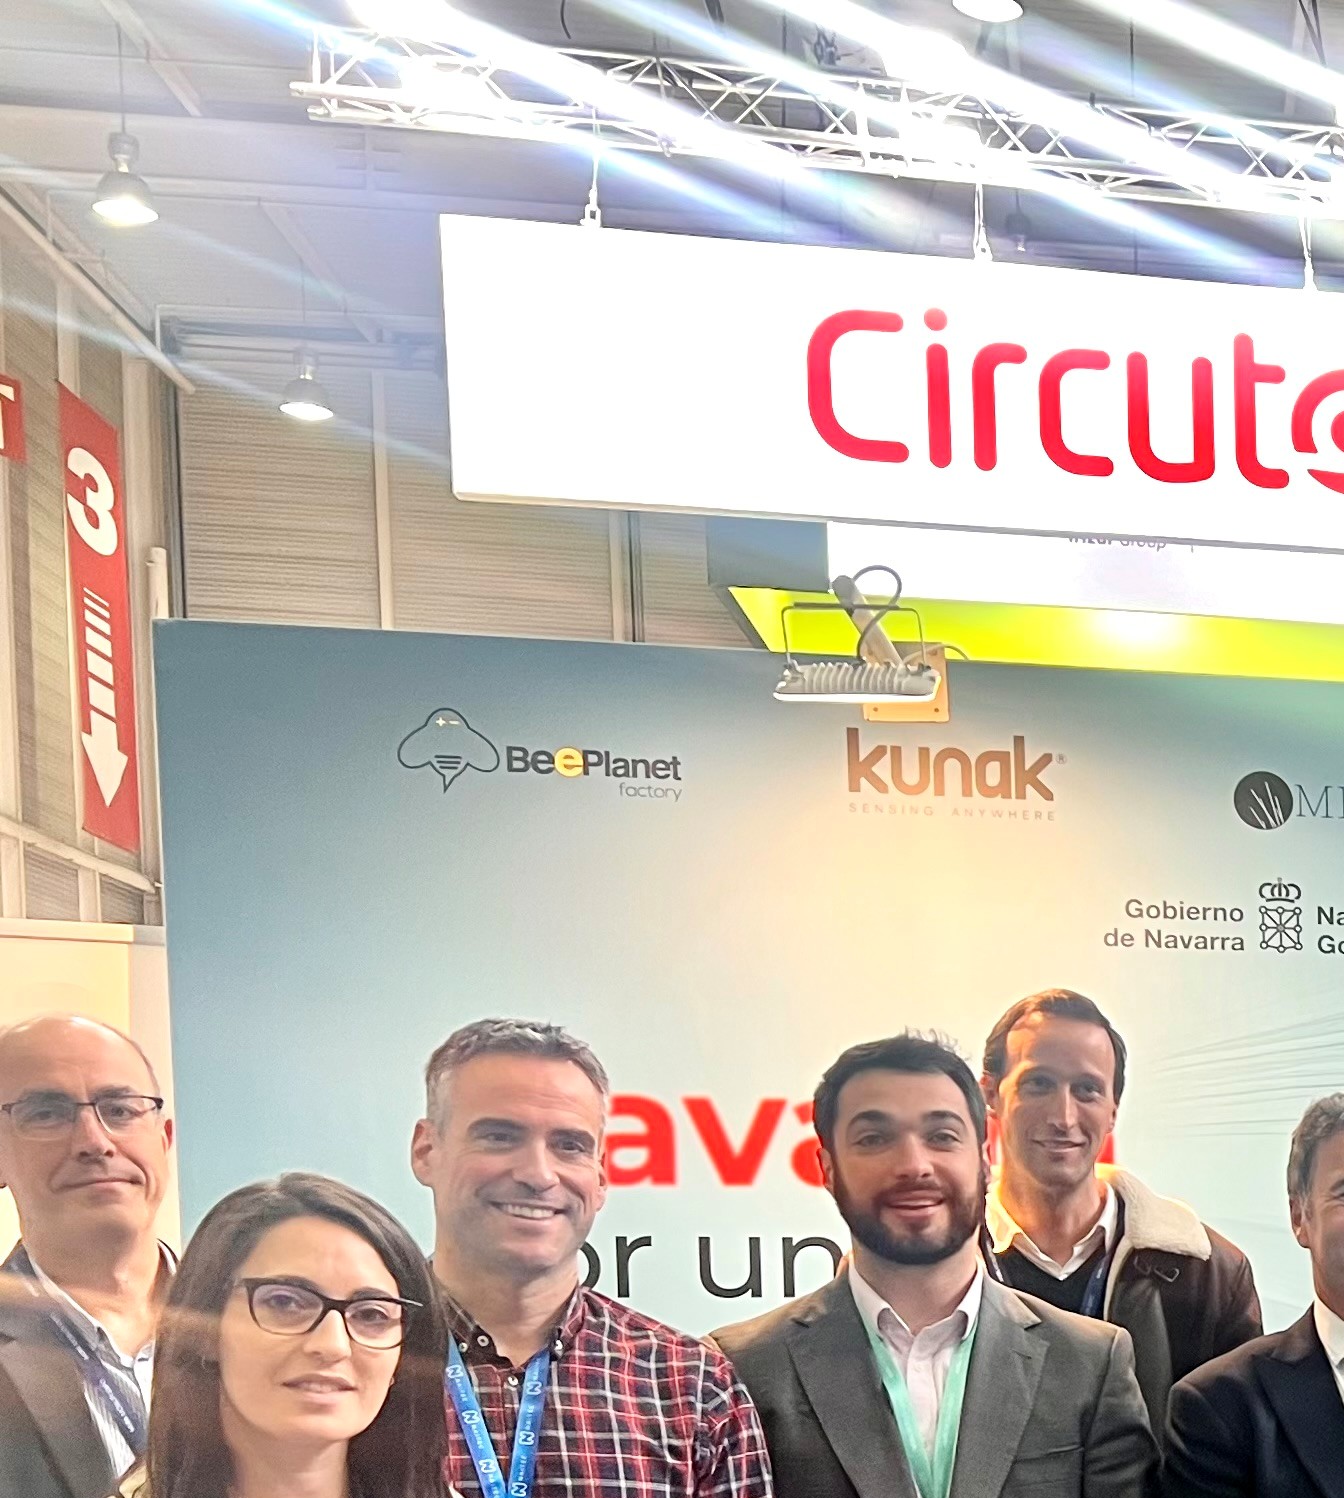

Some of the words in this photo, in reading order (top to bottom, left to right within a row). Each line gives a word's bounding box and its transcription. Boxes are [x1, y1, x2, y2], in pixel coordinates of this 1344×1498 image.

[66, 447, 118, 556] 3
[505, 745, 682, 781] BeePlanet
[619, 782, 683, 802] factory
[849, 802, 934, 816] SENSING
[951, 807, 1056, 821] ANYWHERE
[1125, 898, 1244, 922] Gobierno
[1103, 928, 1135, 947] de
[1144, 929, 1245, 951] Navarra
